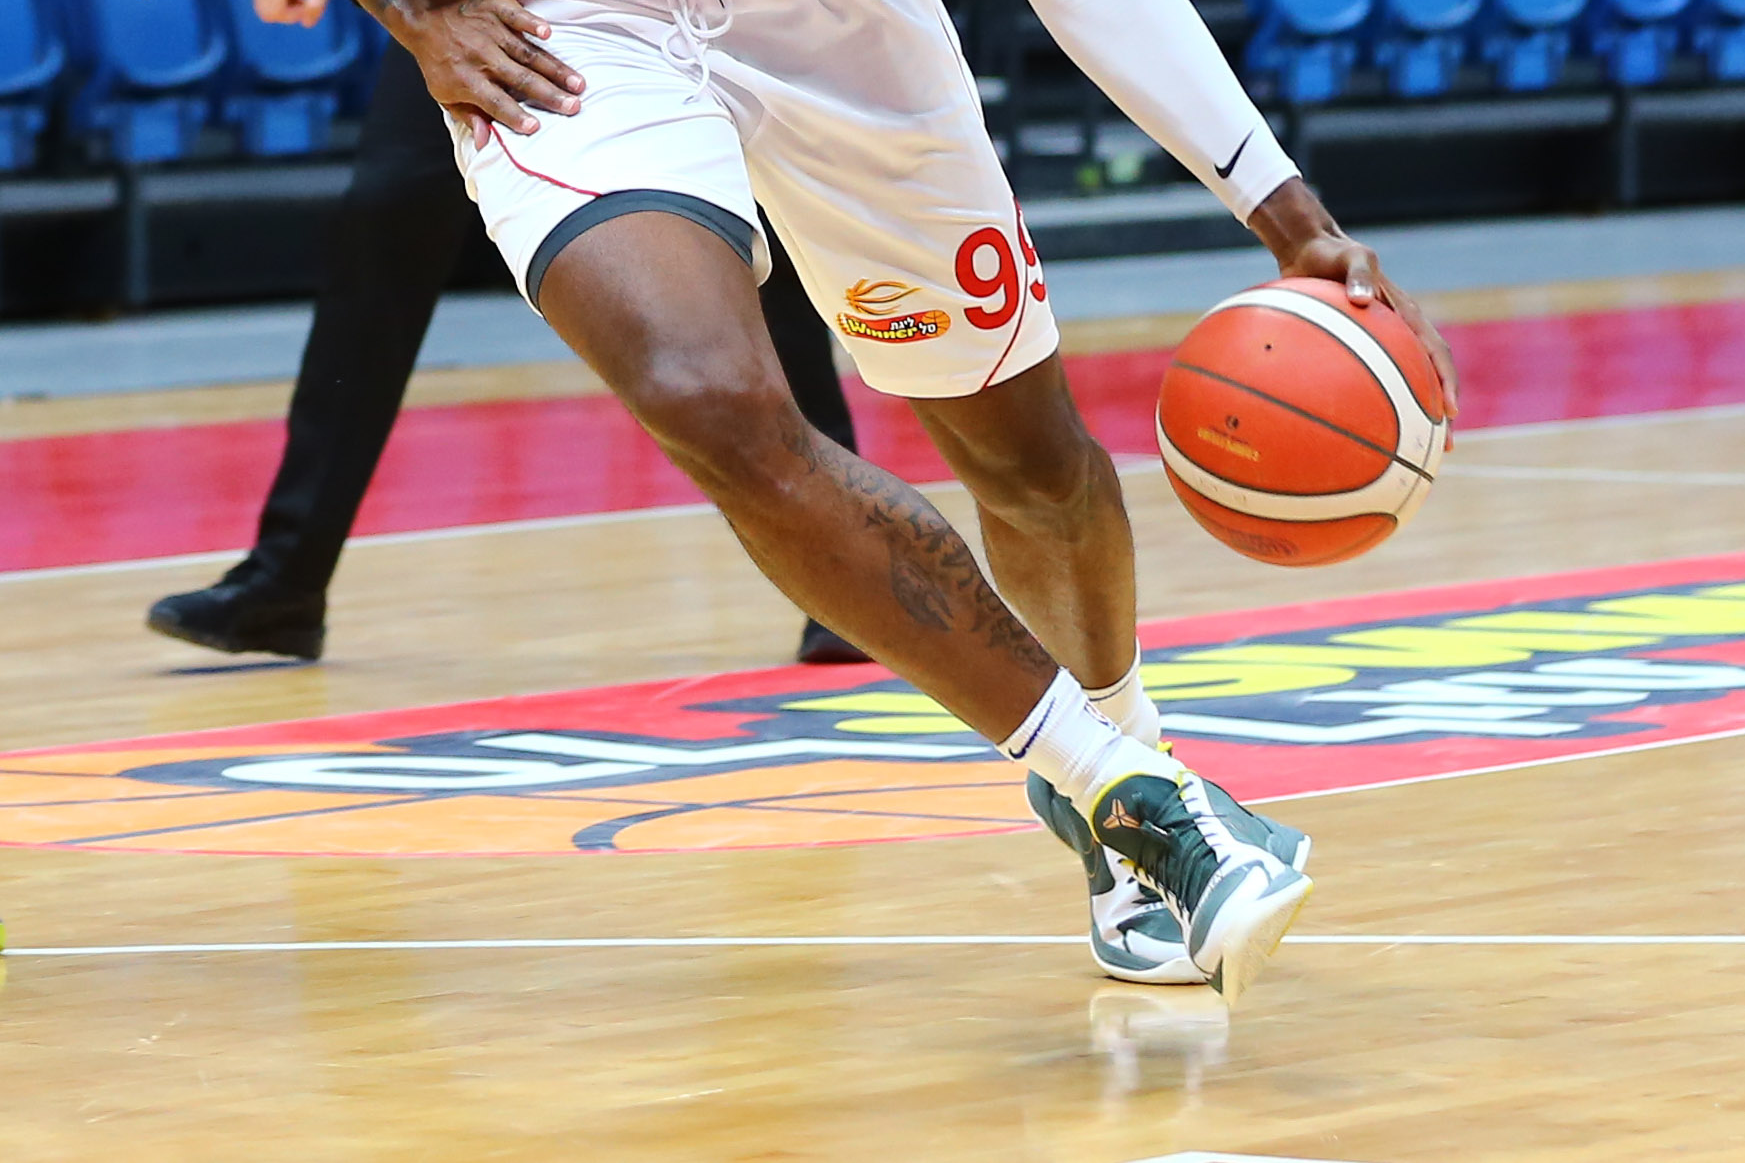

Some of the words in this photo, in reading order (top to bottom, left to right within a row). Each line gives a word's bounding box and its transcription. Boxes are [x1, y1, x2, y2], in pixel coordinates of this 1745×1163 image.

[846, 318, 918, 339] Winner
[890, 316, 915, 331] ליגת
[918, 322, 937, 335] סל
